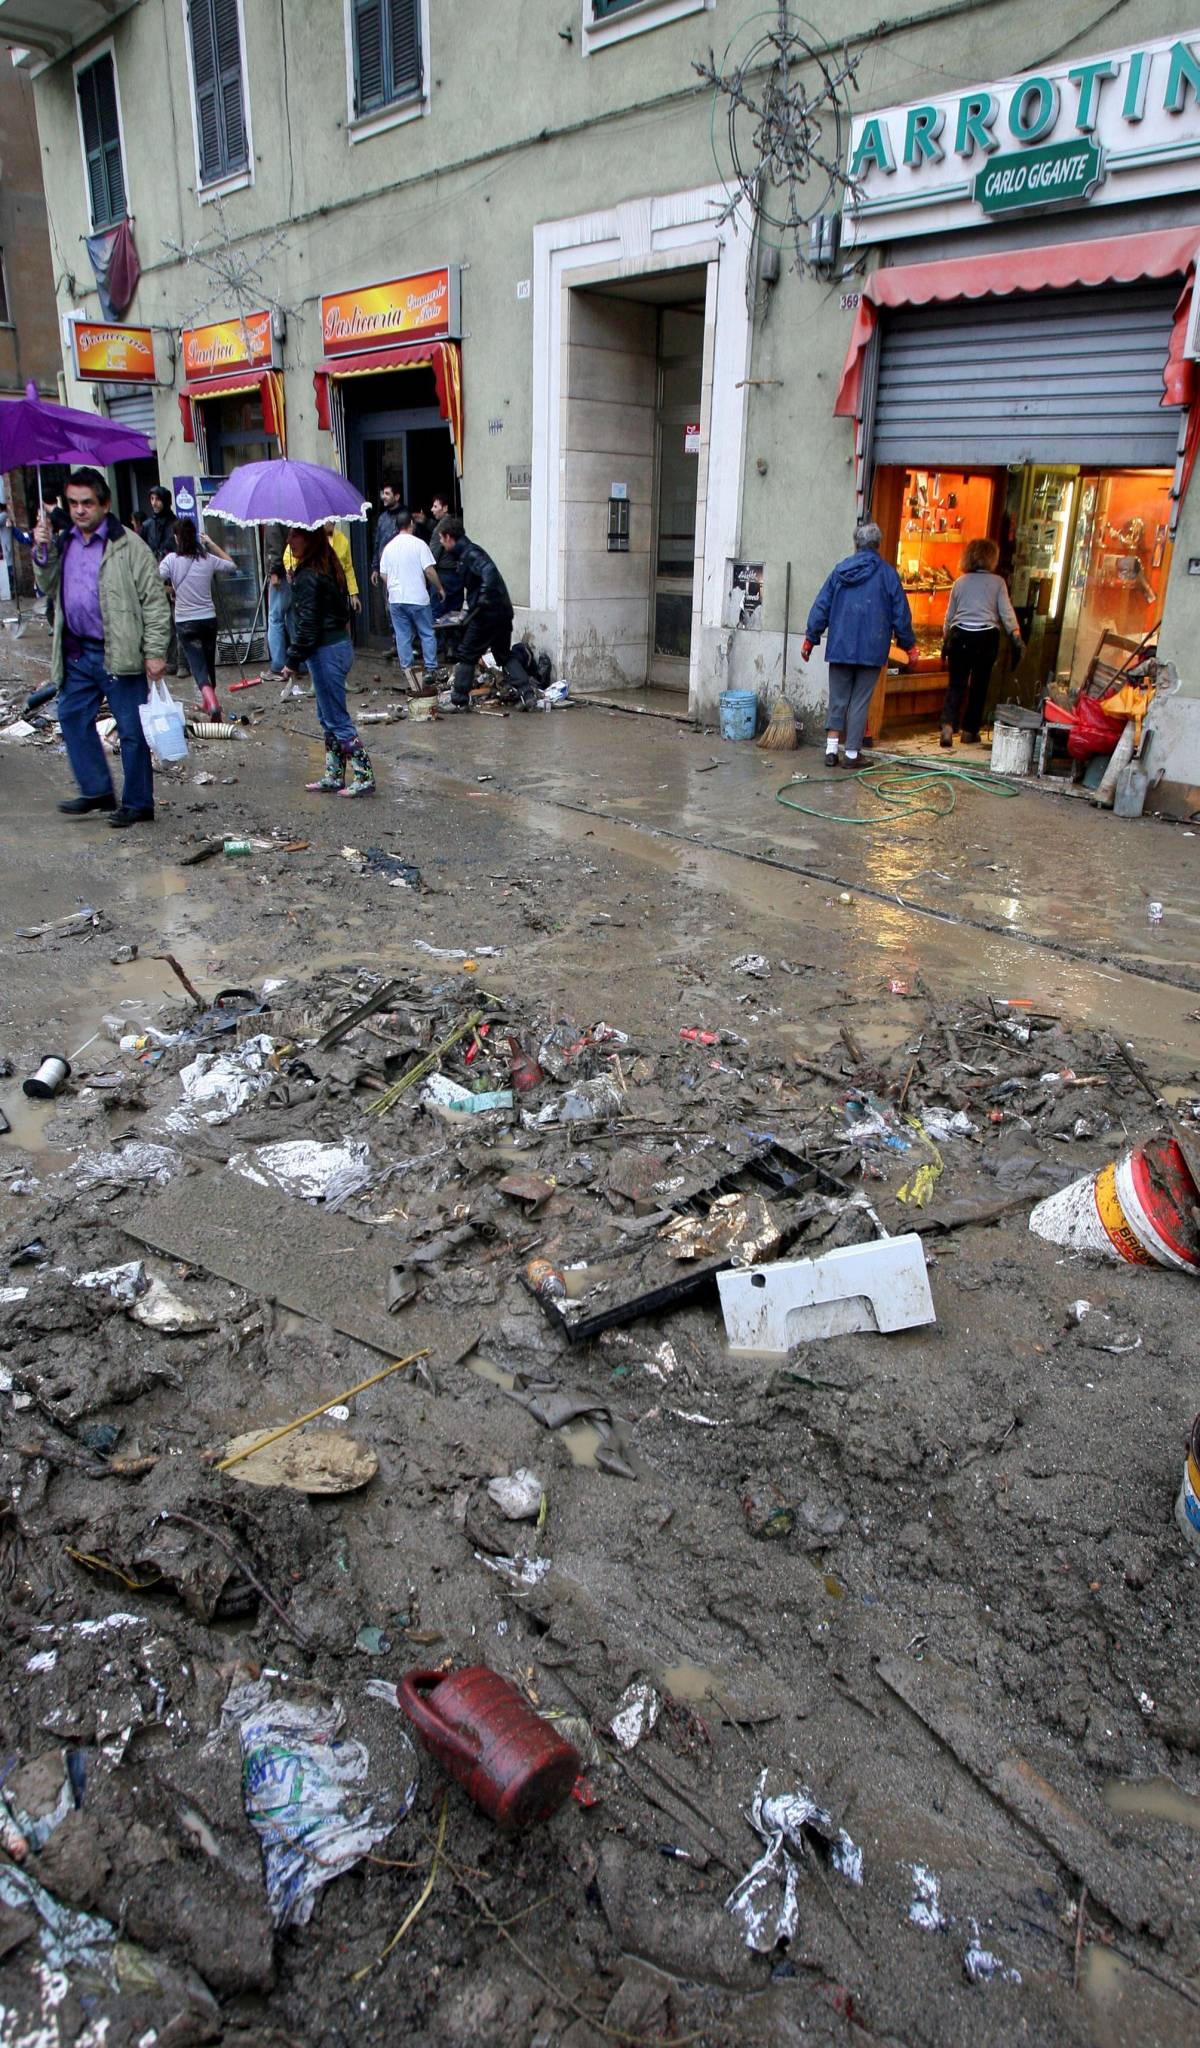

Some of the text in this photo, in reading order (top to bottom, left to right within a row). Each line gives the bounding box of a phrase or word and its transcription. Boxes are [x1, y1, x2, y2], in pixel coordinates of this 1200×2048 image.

[984, 153, 1090, 198] CARLO GIGANTE
[324, 303, 404, 341] Pasticceria
